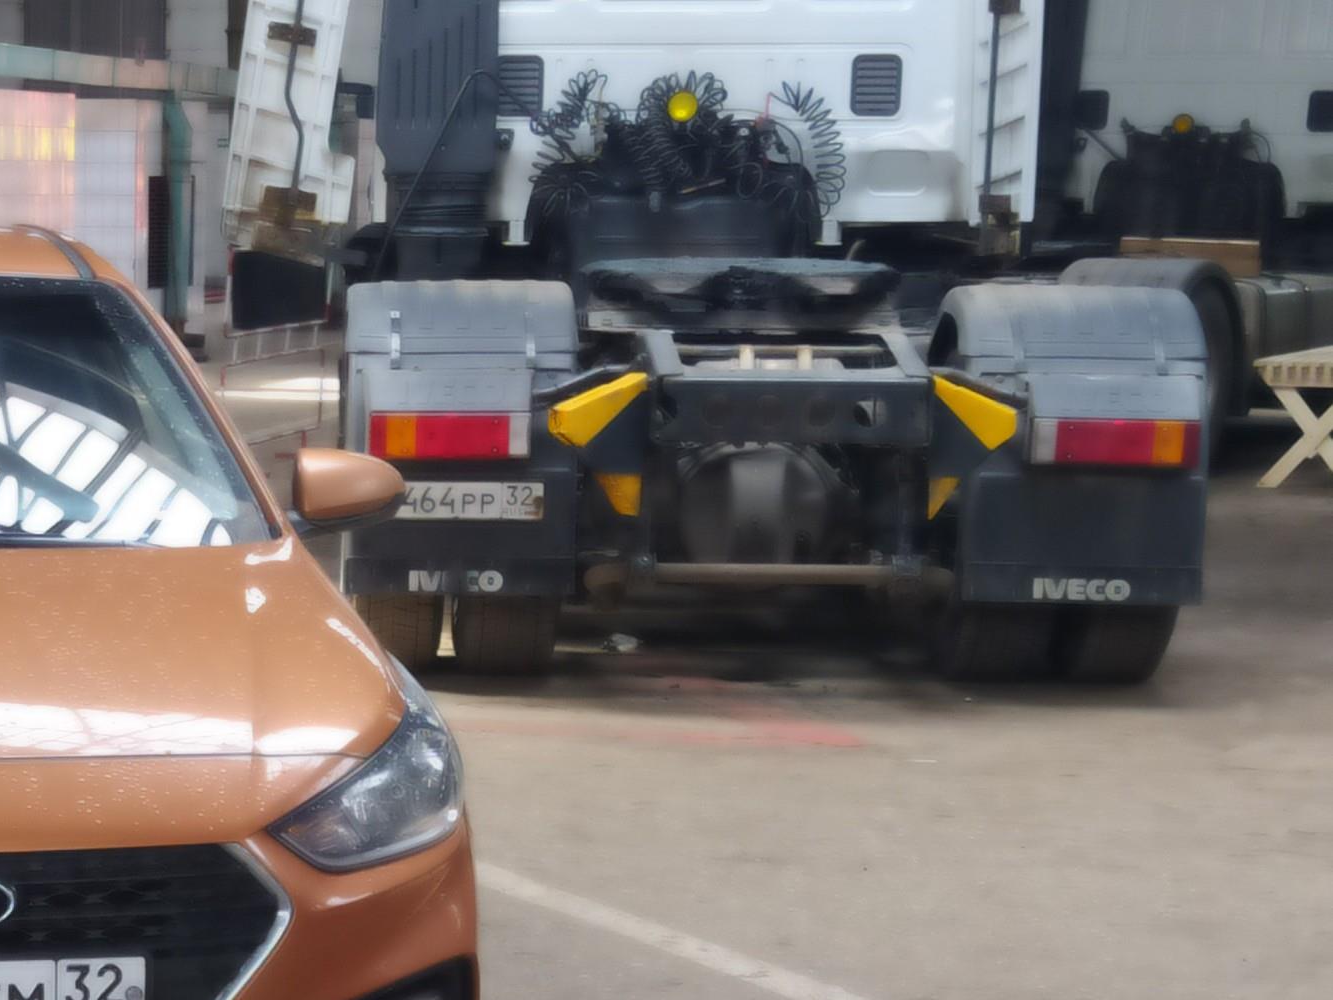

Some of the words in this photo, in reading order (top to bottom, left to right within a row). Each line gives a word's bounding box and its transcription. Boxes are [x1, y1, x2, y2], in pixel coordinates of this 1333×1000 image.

[402, 486, 495, 514] 464РР
[506, 485, 534, 506] 32
[408, 570, 503, 592] IVCO
[1032, 577, 1131, 601] IVECO
